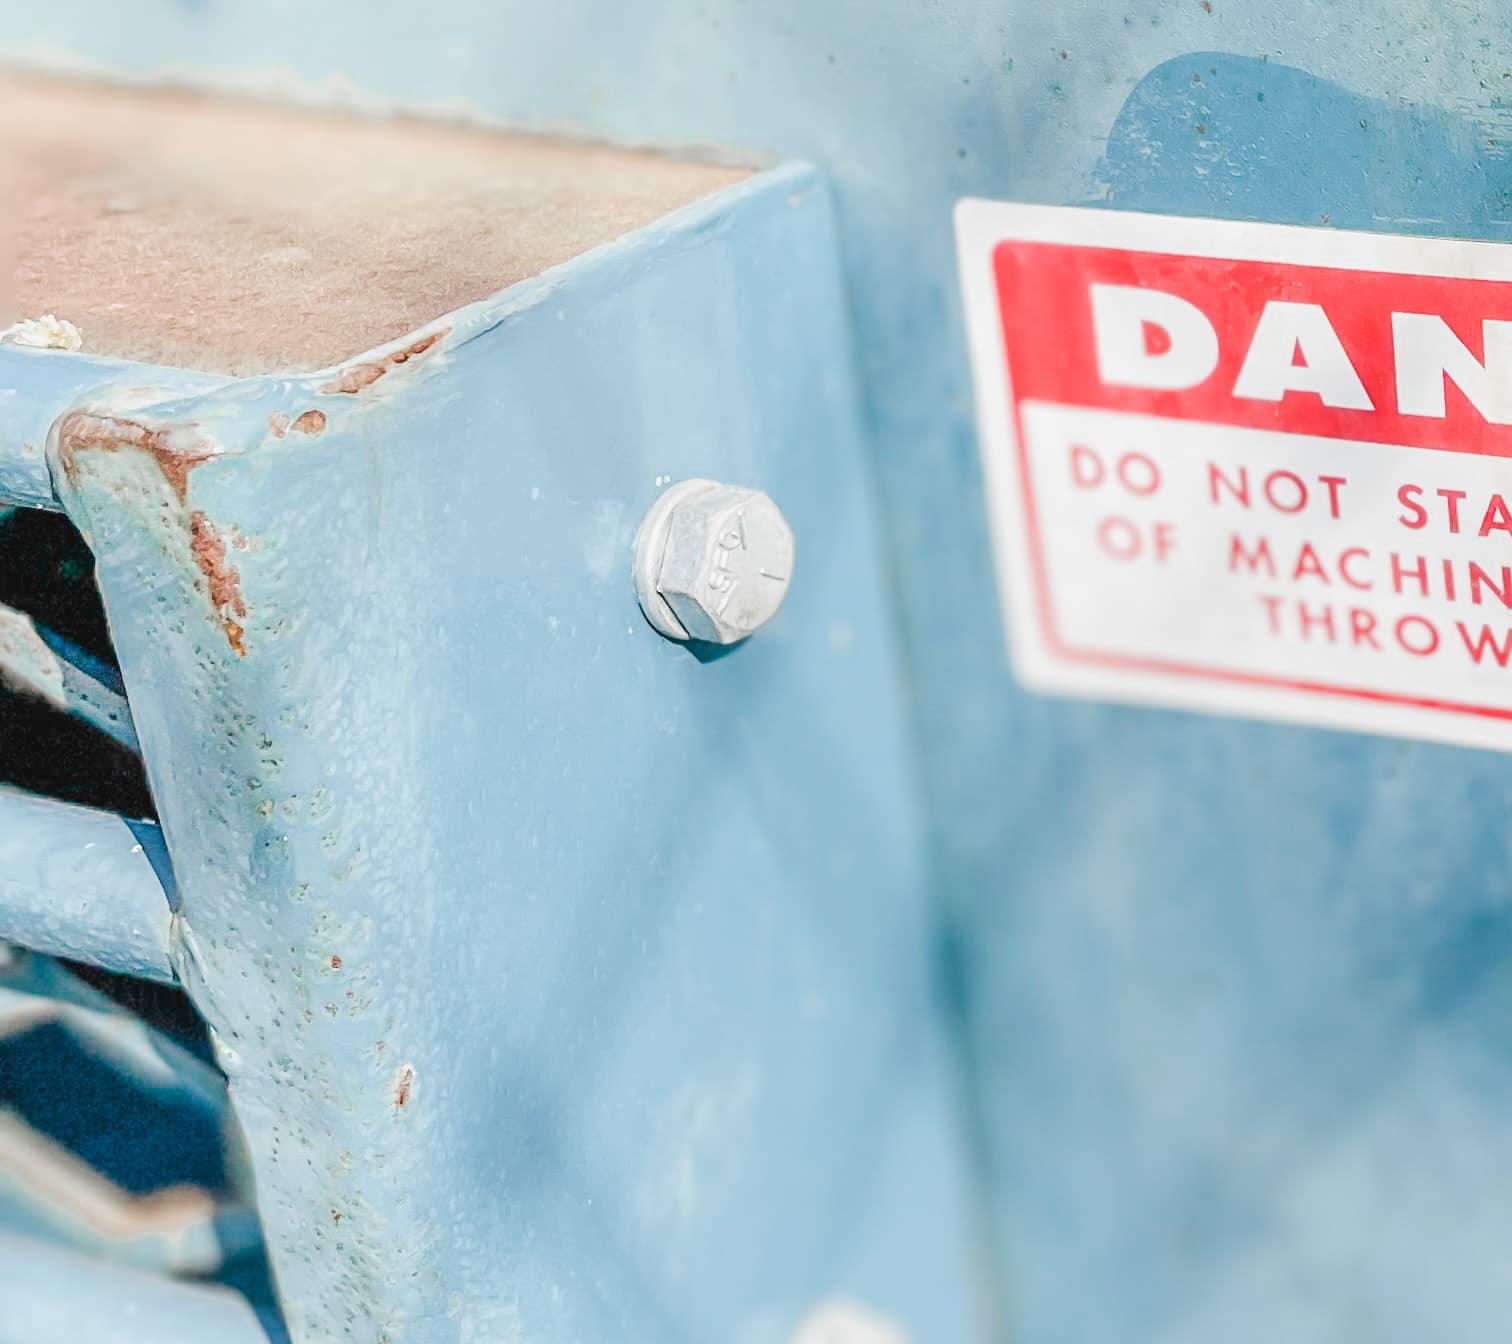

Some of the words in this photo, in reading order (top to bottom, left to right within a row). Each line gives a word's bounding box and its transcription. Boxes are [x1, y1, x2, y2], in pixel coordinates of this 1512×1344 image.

[1069, 443, 1163, 497] DO
[1207, 460, 1348, 521] NOT
[1096, 515, 1177, 564] OF
